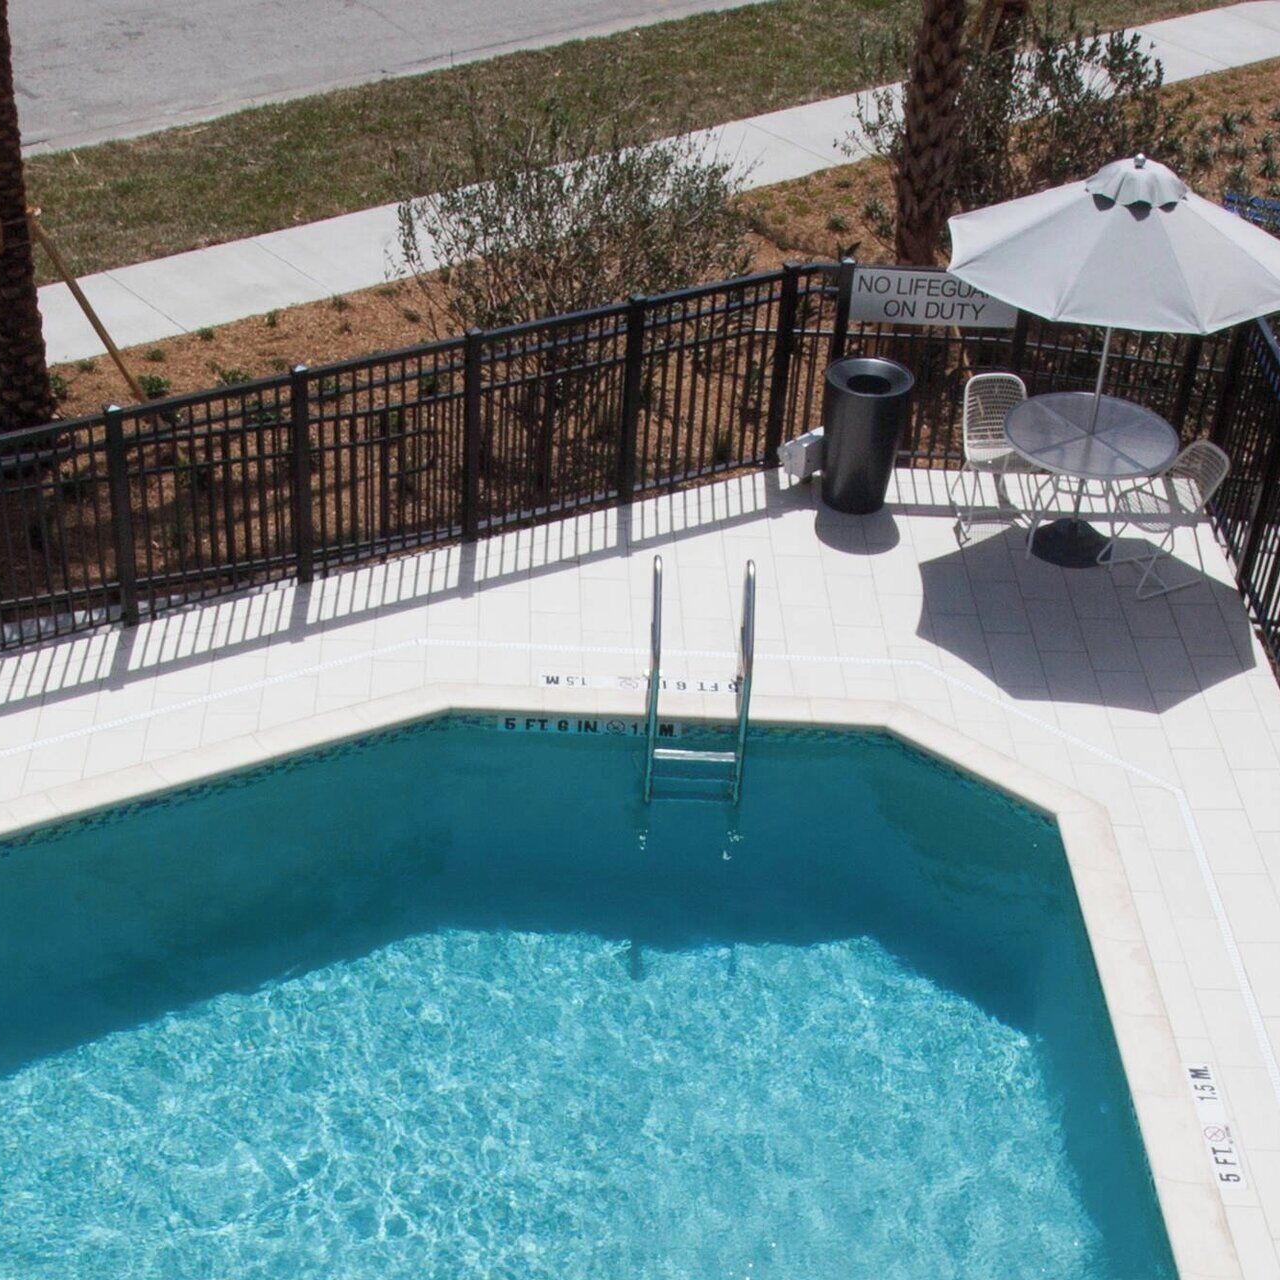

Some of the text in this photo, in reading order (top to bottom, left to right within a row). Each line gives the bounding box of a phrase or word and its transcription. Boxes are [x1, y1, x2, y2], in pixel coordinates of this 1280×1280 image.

[858, 275, 990, 299] NO LIFEGUA
[884, 299, 986, 321] ON DUTY
[504, 717, 516, 730] 5
[1194, 1084, 1218, 1101] 1.5
[1220, 1172, 1241, 1183] 5
